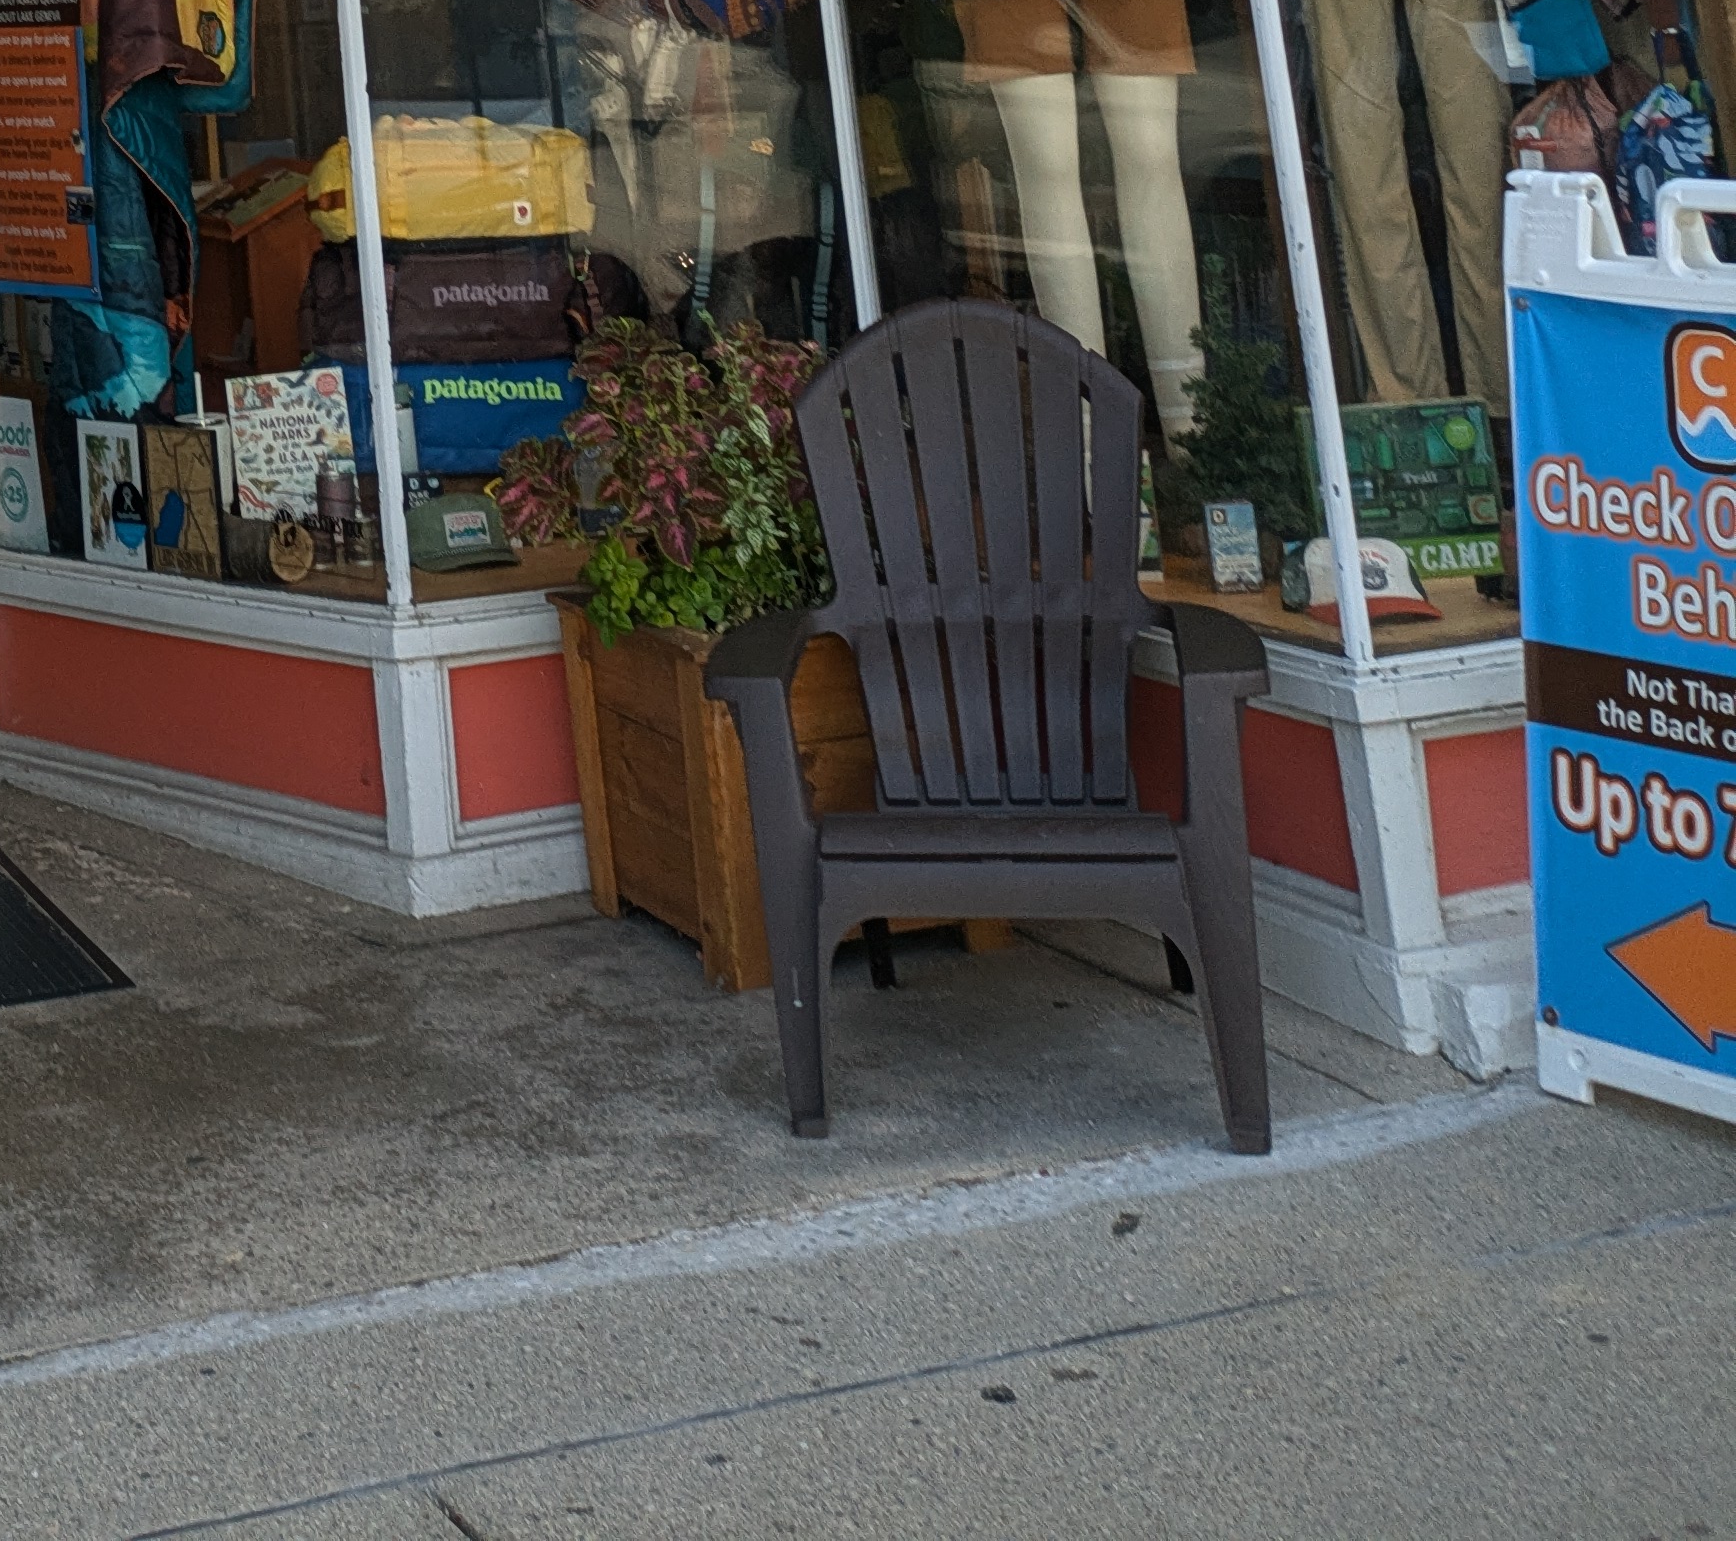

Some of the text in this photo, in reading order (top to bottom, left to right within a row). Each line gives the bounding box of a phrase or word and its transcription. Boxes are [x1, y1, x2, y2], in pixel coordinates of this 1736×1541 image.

[432, 280, 551, 308] patagonia
[422, 375, 564, 406] patagonia
[259, 413, 321, 431] NATIONAL
[271, 427, 312, 443] PARKS
[1533, 460, 1692, 547] Check
[1419, 539, 1499, 572] CAMP
[1626, 668, 1678, 706] Not
[1596, 697, 1643, 733] the
[1649, 707, 1717, 749] Back
[1553, 750, 1637, 853] Up
[1644, 777, 1711, 855] to
